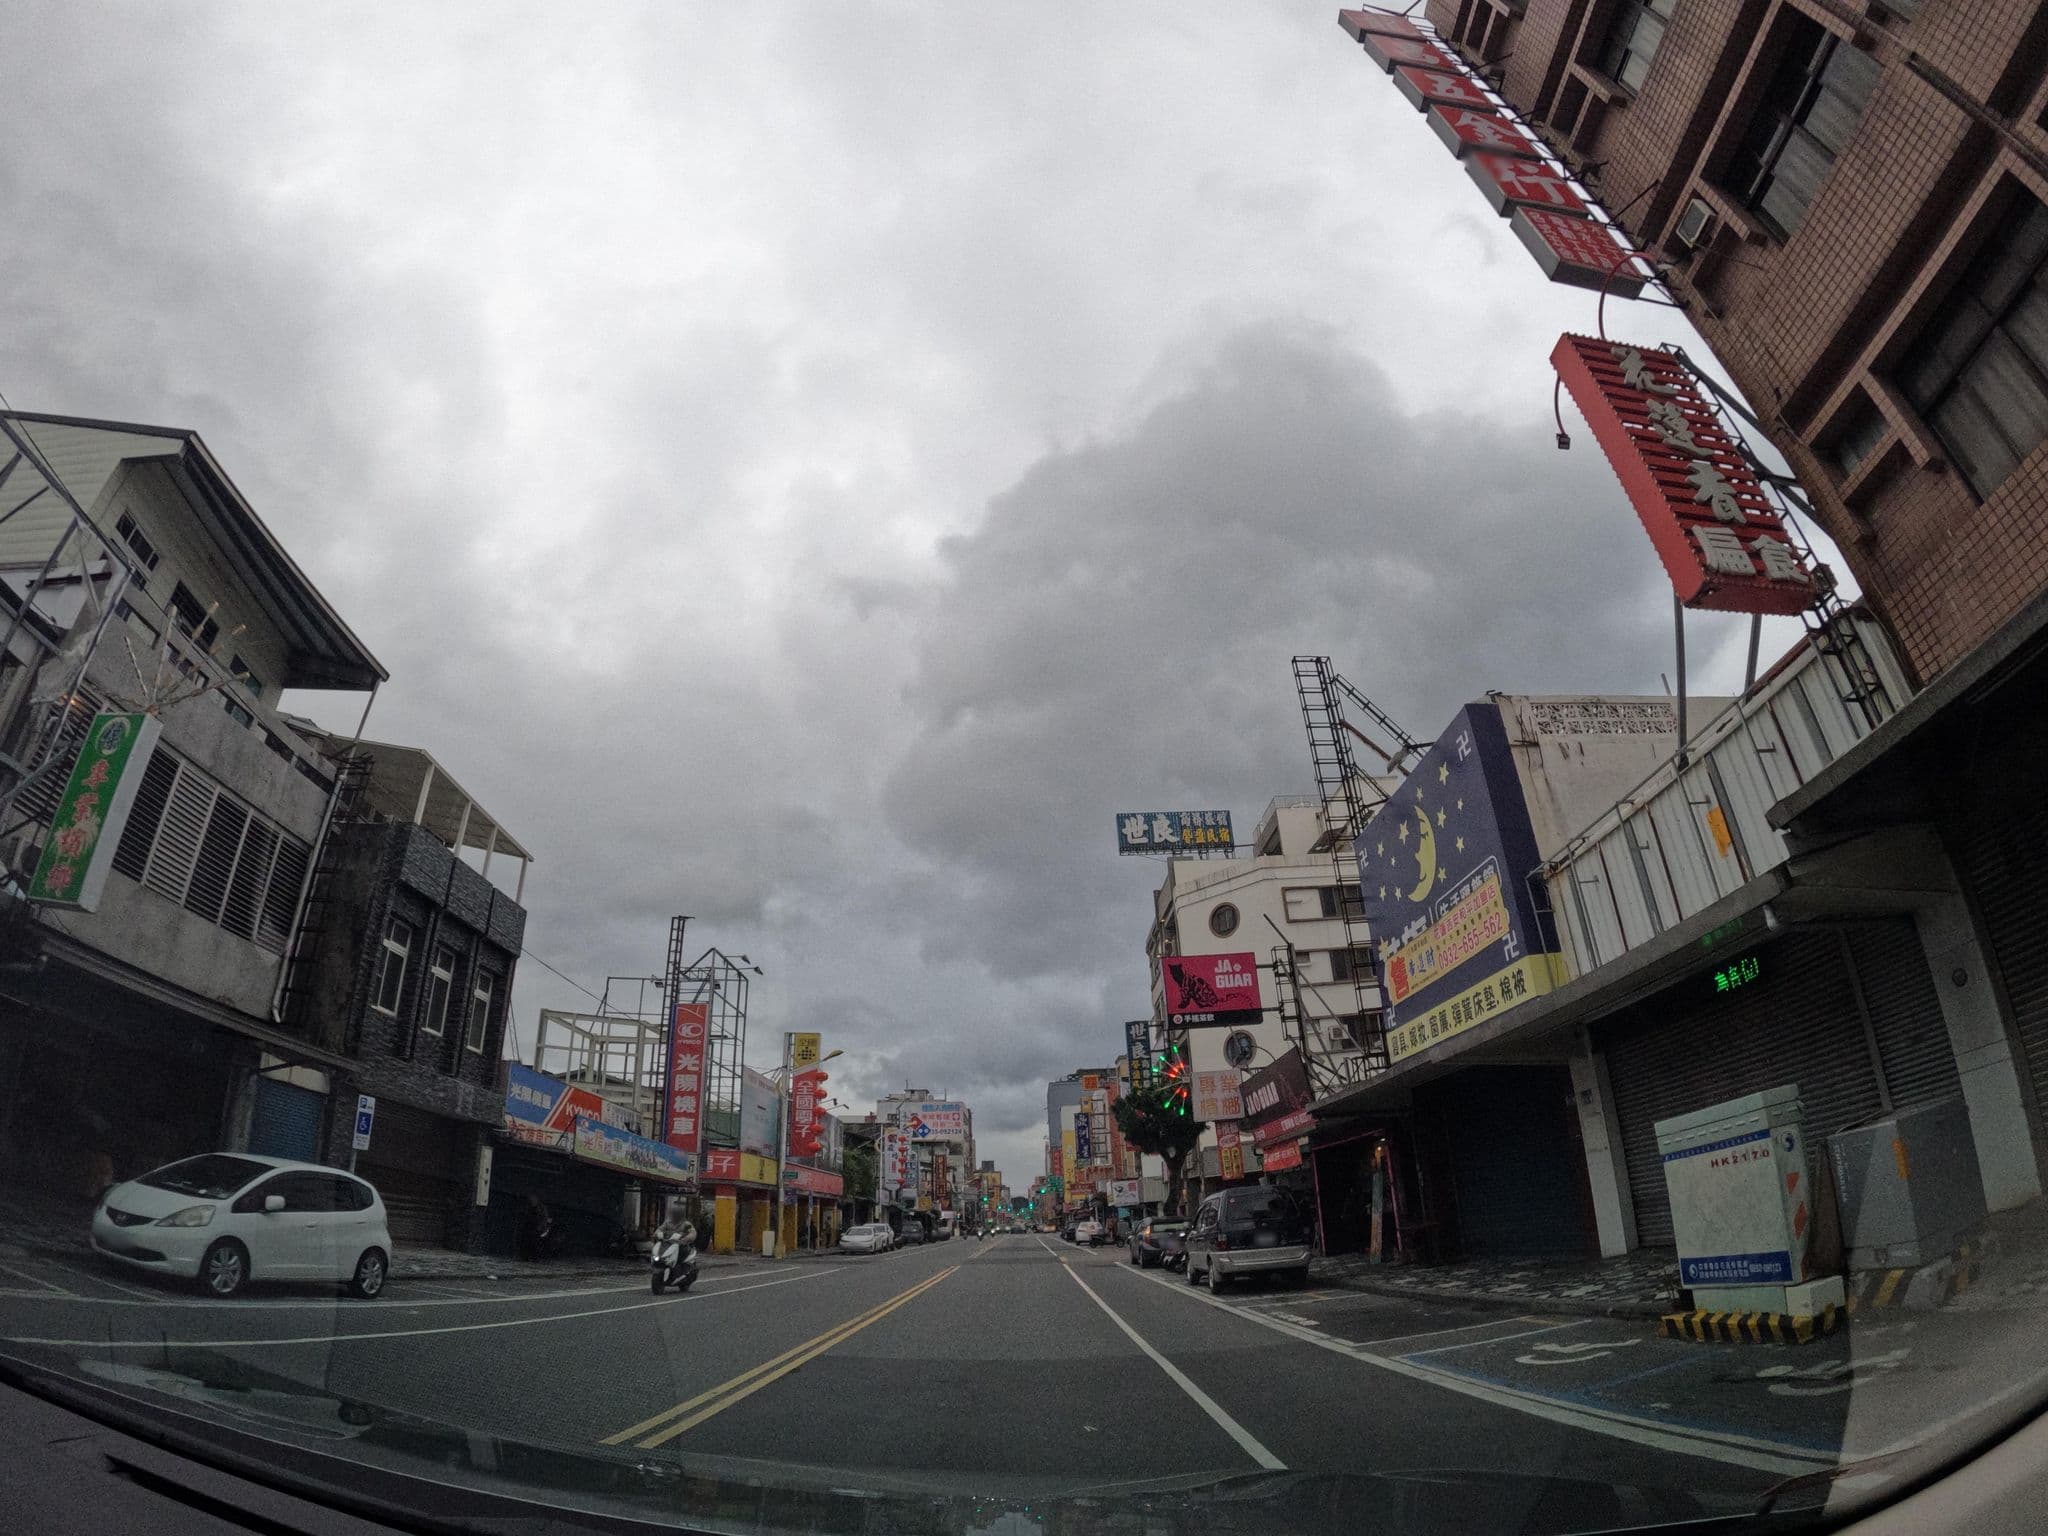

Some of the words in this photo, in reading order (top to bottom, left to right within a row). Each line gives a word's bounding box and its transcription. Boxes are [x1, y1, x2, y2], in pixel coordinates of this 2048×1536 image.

[1215, 960, 1232, 974] JA
[1215, 973, 1252, 988] GUAR
[673, 1053, 702, 1136] 光陽機車
[1710, 1150, 1770, 1168] HK2170
